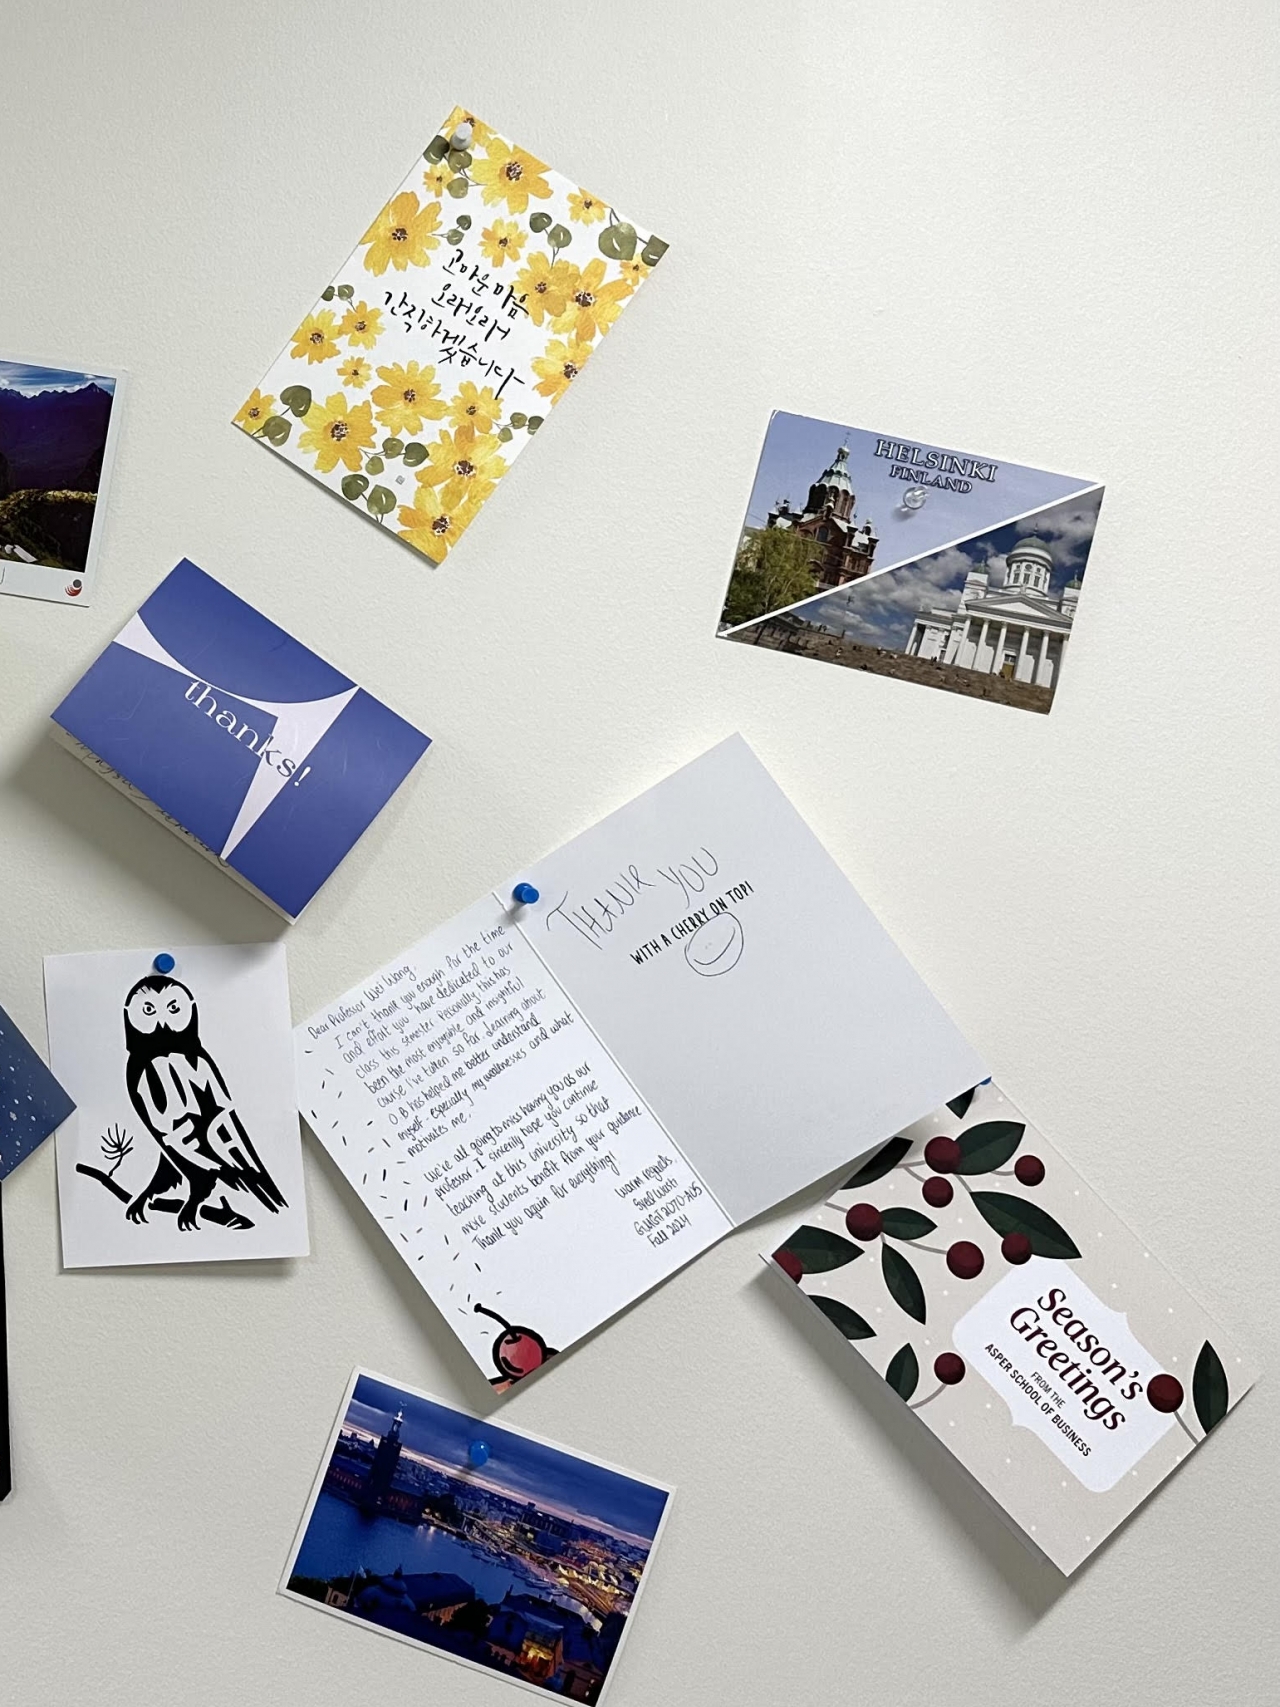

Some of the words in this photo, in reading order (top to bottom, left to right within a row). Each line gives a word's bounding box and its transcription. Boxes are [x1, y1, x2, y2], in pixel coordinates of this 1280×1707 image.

[431, 283, 511, 342] 오래오래
[442, 248, 490, 297] 고마운
[493, 282, 530, 320] 마음
[384, 291, 525, 400] 간직하겠습니다
[874, 438, 999, 483] HELSINKI
[889, 464, 973, 495] FINLAND
[183, 680, 312, 788] thanks!
[546, 864, 655, 950] THANK
[657, 846, 719, 911] YOU
[629, 939, 663, 967] WITH
[660, 931, 673, 947] A
[672, 909, 712, 942] CHERRY
[709, 896, 729, 917] ON
[726, 880, 755, 906] TOP!
[444, 953, 463, 971] for
[460, 941, 482, 960] the
[479, 925, 506, 946] time
[306, 1022, 331, 1040] Dear
[326, 999, 367, 1028] Professor
[362, 983, 386, 1003] Wei
[333, 1033, 345, 1051] I
[345, 1018, 371, 1042] can't
[369, 999, 402, 1024] thank
[399, 989, 425, 1011] you
[445, 1184, 496, 1218] teaching
[491, 1170, 507, 1188] at
[503, 1158, 528, 1179] this
[527, 1124, 579, 1163] university
[1009, 1306, 1127, 1431] Greetings
[1036, 1287, 1144, 1401] Season's
[983, 1343, 1014, 1373] ASPER
[1008, 1368, 1043, 1407] SCHOOL
[1039, 1401, 1056, 1416] OF
[1050, 1413, 1092, 1458] BUSINESS
[1029, 1370, 1053, 1395] FROM
[1049, 1390, 1067, 1410] THE
